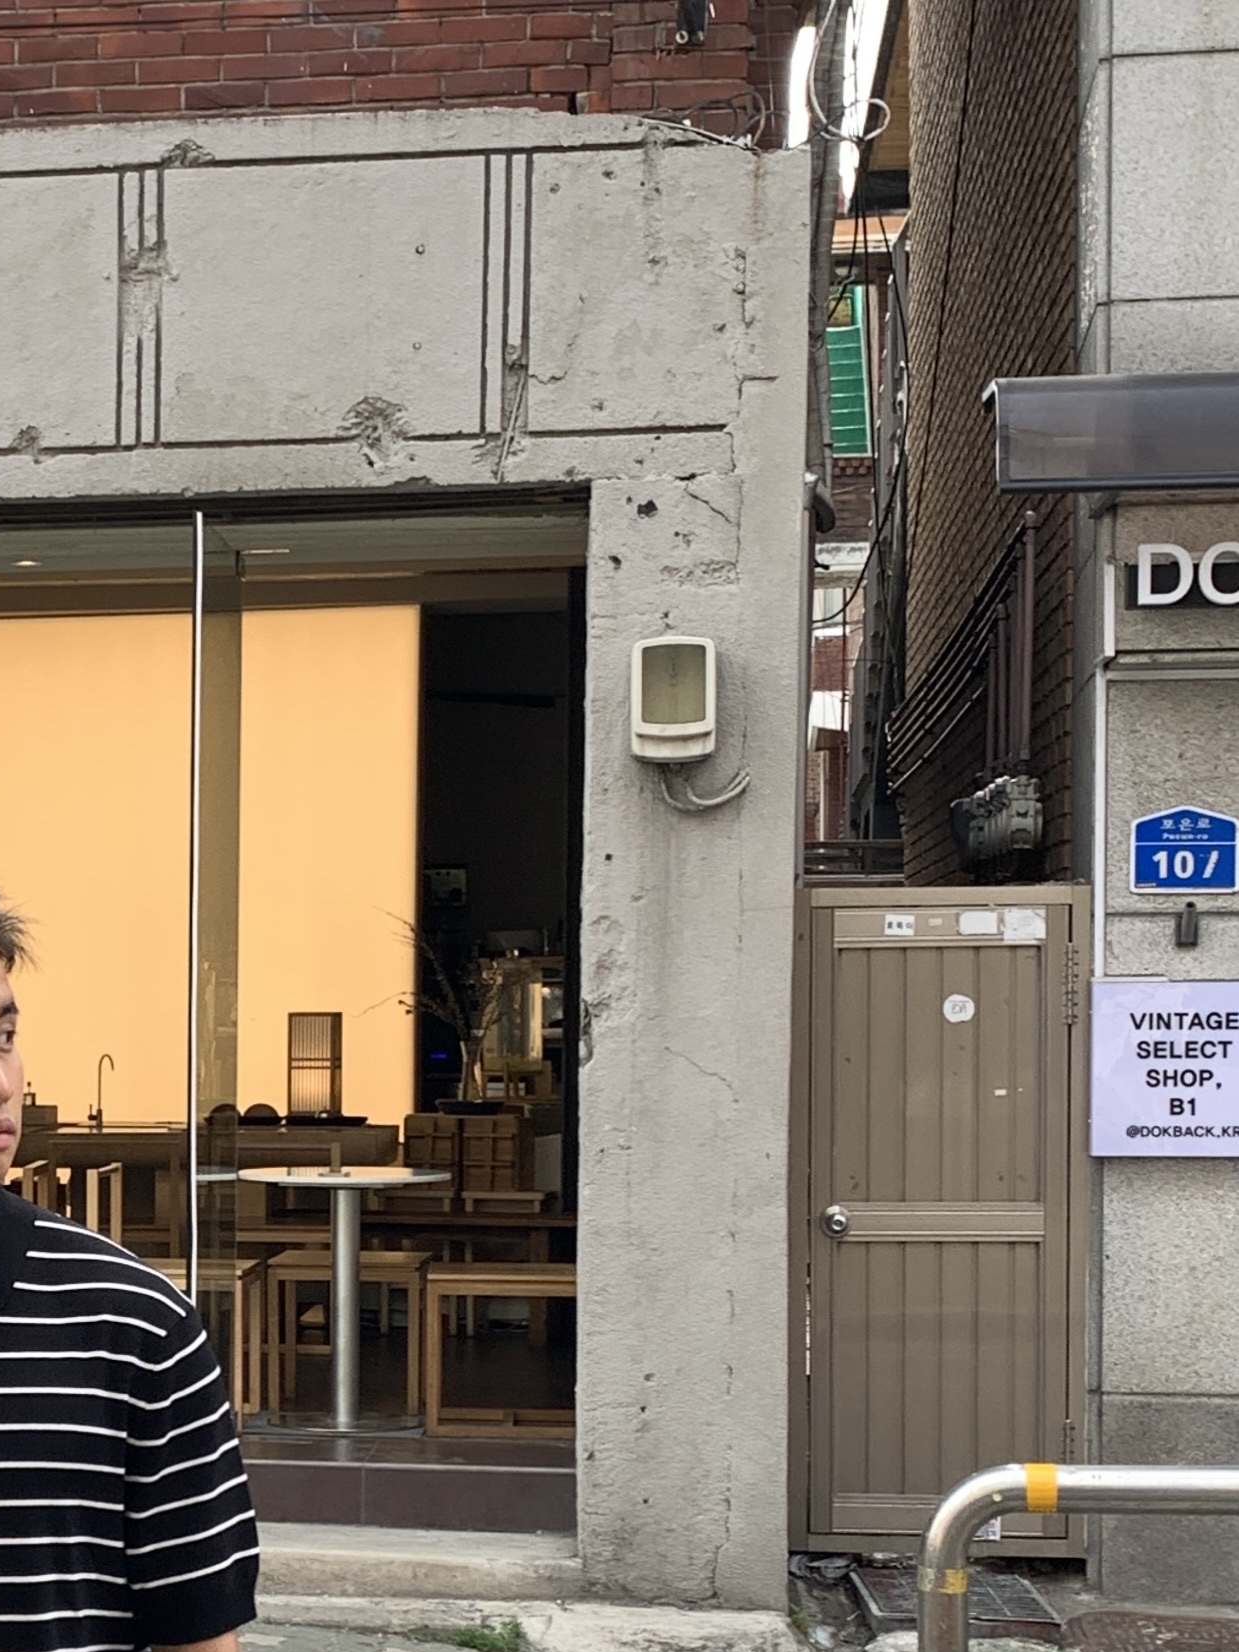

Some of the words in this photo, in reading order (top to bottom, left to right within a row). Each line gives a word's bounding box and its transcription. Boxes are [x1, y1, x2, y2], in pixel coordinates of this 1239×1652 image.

[1130, 1012, 1239, 1031] VINTAGE
[1136, 1040, 1233, 1059] SELECT
[1145, 1068, 1222, 1090] SHOP,
[1169, 1098, 1196, 1116] B1
